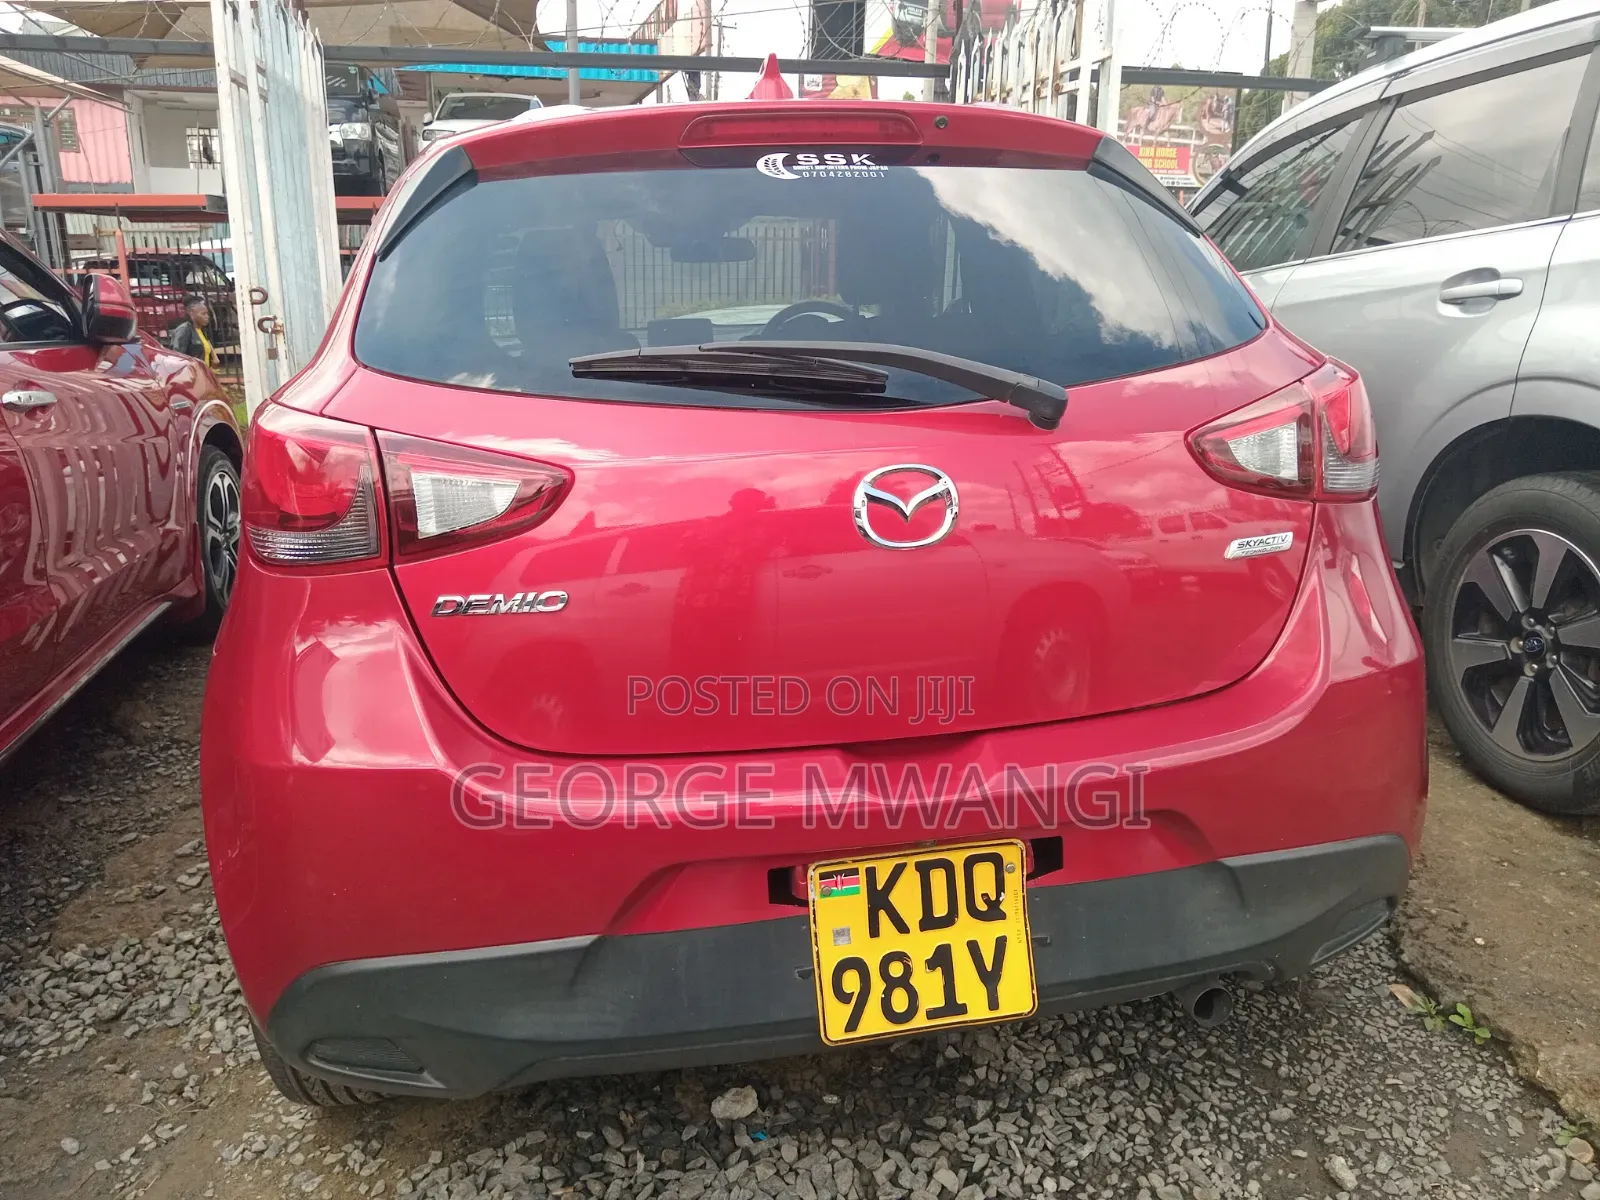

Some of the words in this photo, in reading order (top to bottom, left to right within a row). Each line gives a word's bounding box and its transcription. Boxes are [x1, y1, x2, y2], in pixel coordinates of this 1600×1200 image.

[796, 153, 876, 165] SSK
[1154, 158, 1179, 169] SCHOOL
[1237, 534, 1288, 549] SKYACTIV
[431, 590, 569, 617] DEMIO
[865, 852, 1007, 938] KDQ
[831, 935, 1007, 1033] 981Y
